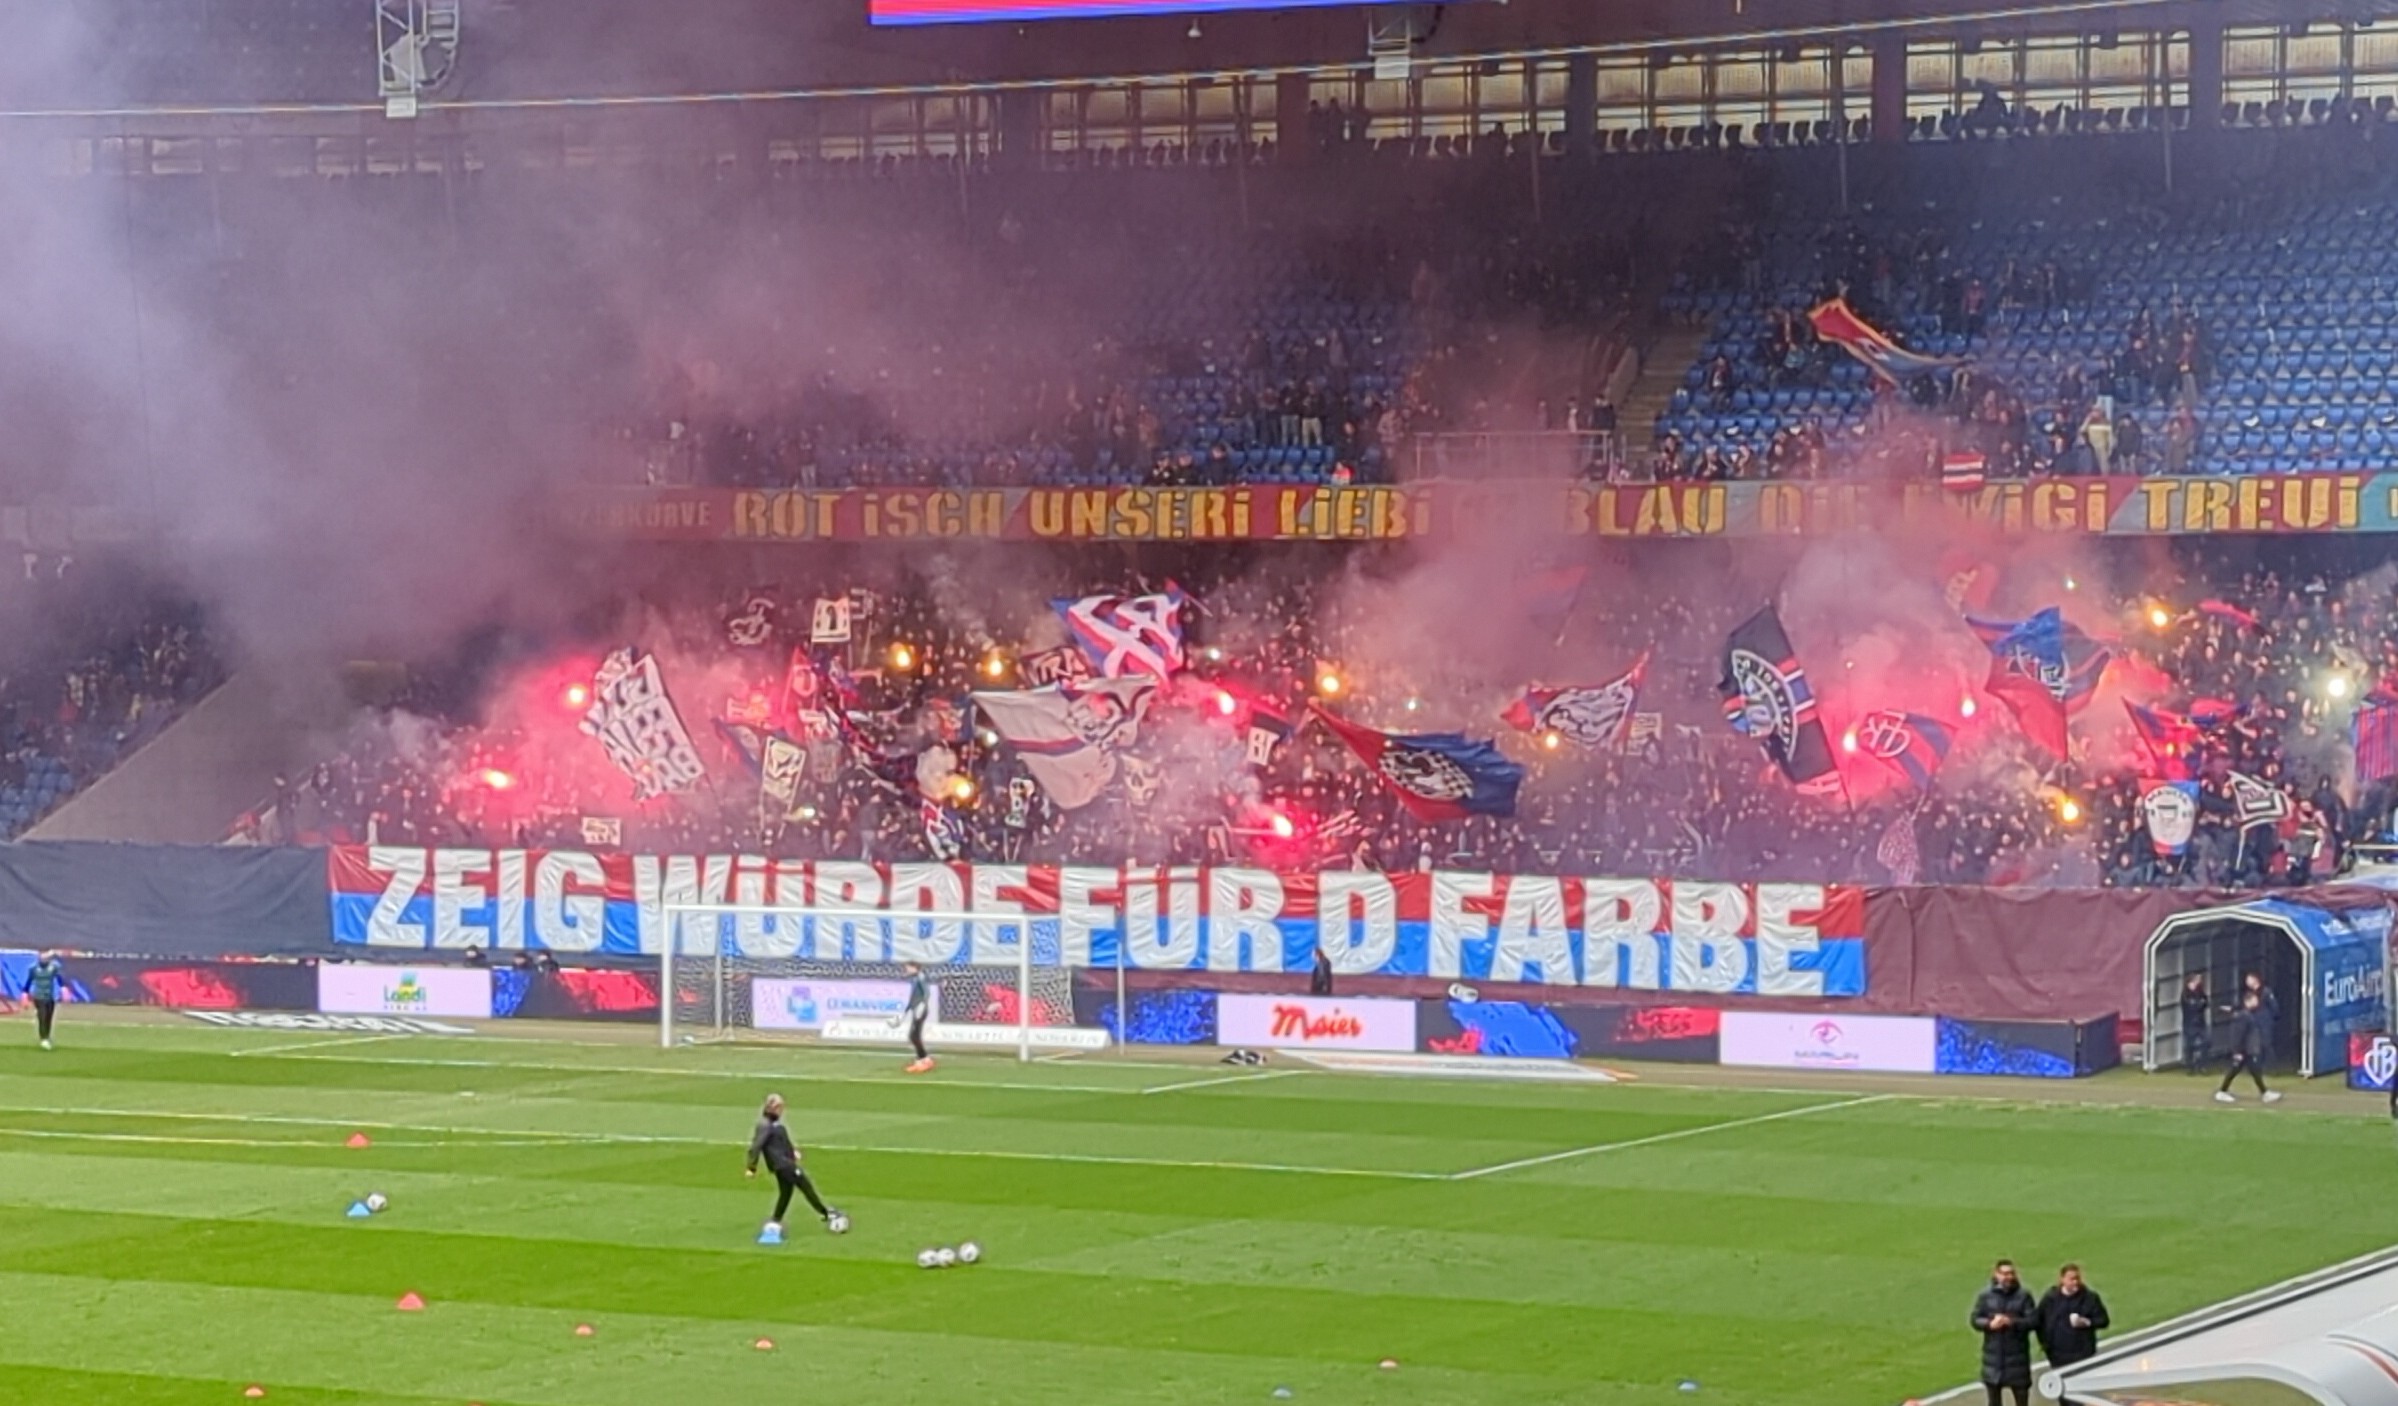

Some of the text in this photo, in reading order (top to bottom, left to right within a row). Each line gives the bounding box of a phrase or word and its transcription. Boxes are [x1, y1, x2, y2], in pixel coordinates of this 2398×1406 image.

[733, 491, 839, 538] ROT
[367, 846, 1826, 996] ZEIG WÜRDE FÜR D FARBE
